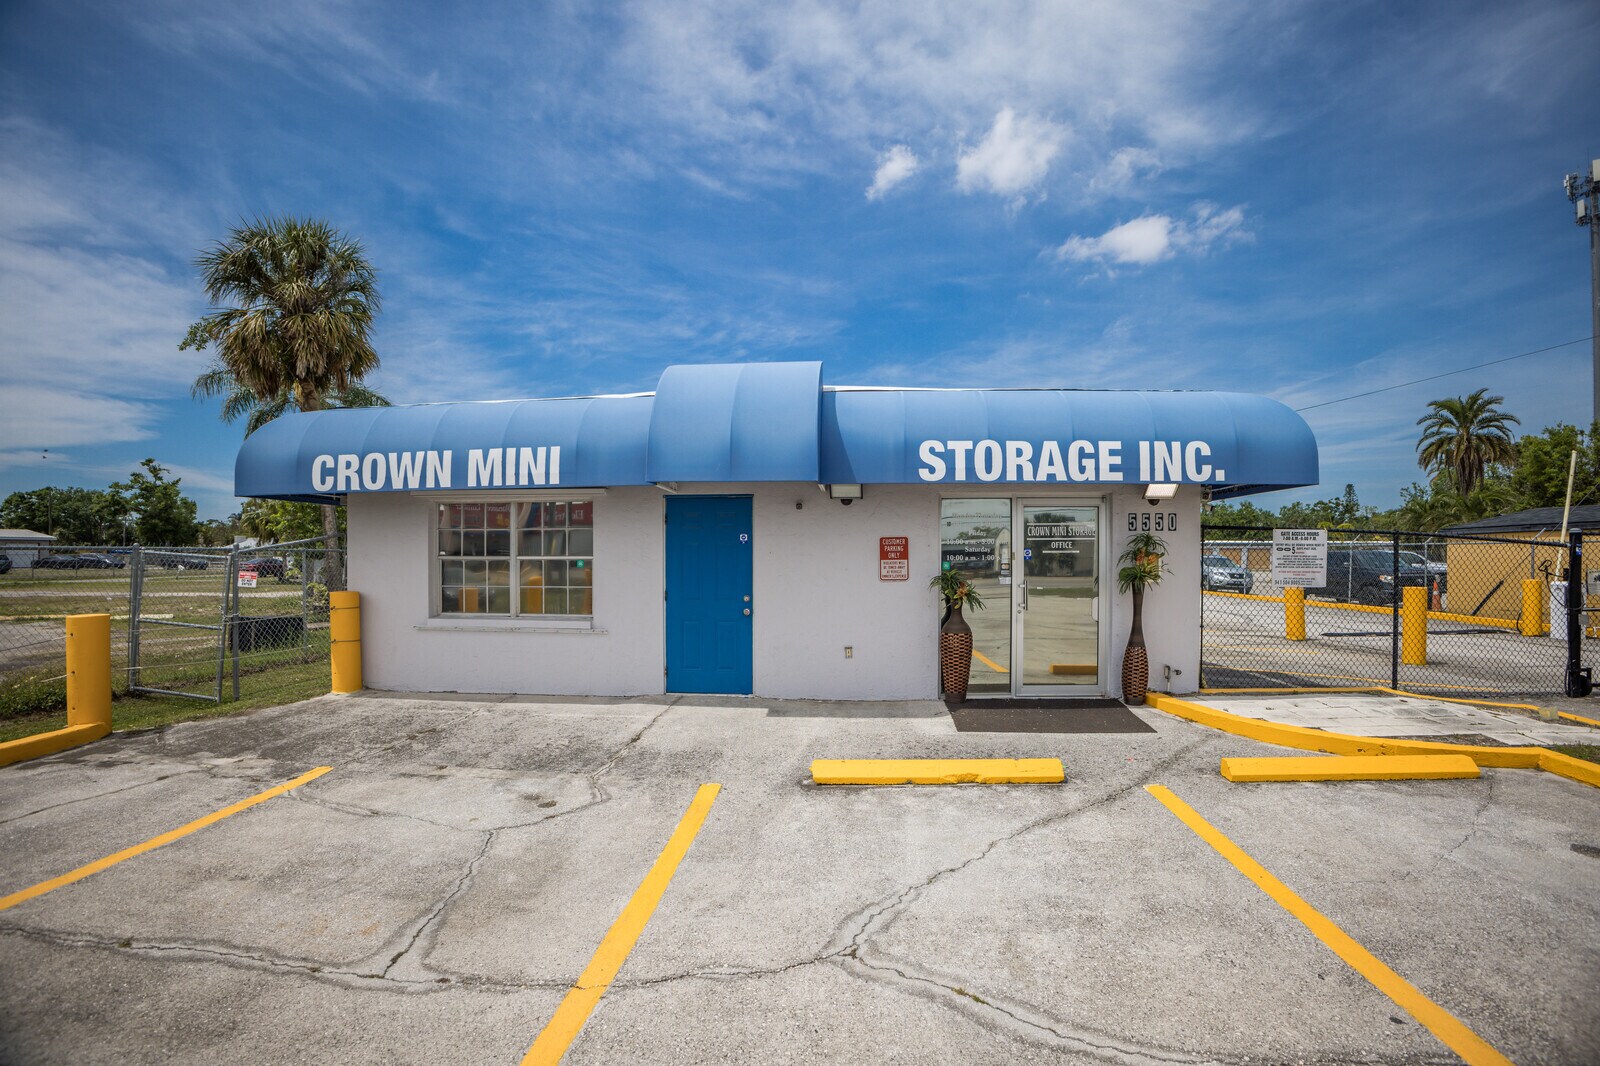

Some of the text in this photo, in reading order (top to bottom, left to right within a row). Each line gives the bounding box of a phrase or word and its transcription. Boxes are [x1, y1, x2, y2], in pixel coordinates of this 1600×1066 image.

[918, 439, 1226, 482] STORAGE INC.
[311, 446, 561, 492] CROWN MINI
[1128, 513, 1177, 531] 5550
[1027, 526, 1096, 536] CROWN MINI STORAGE
[964, 545, 991, 554] Saturday
[1051, 541, 1073, 549] OFFICE
